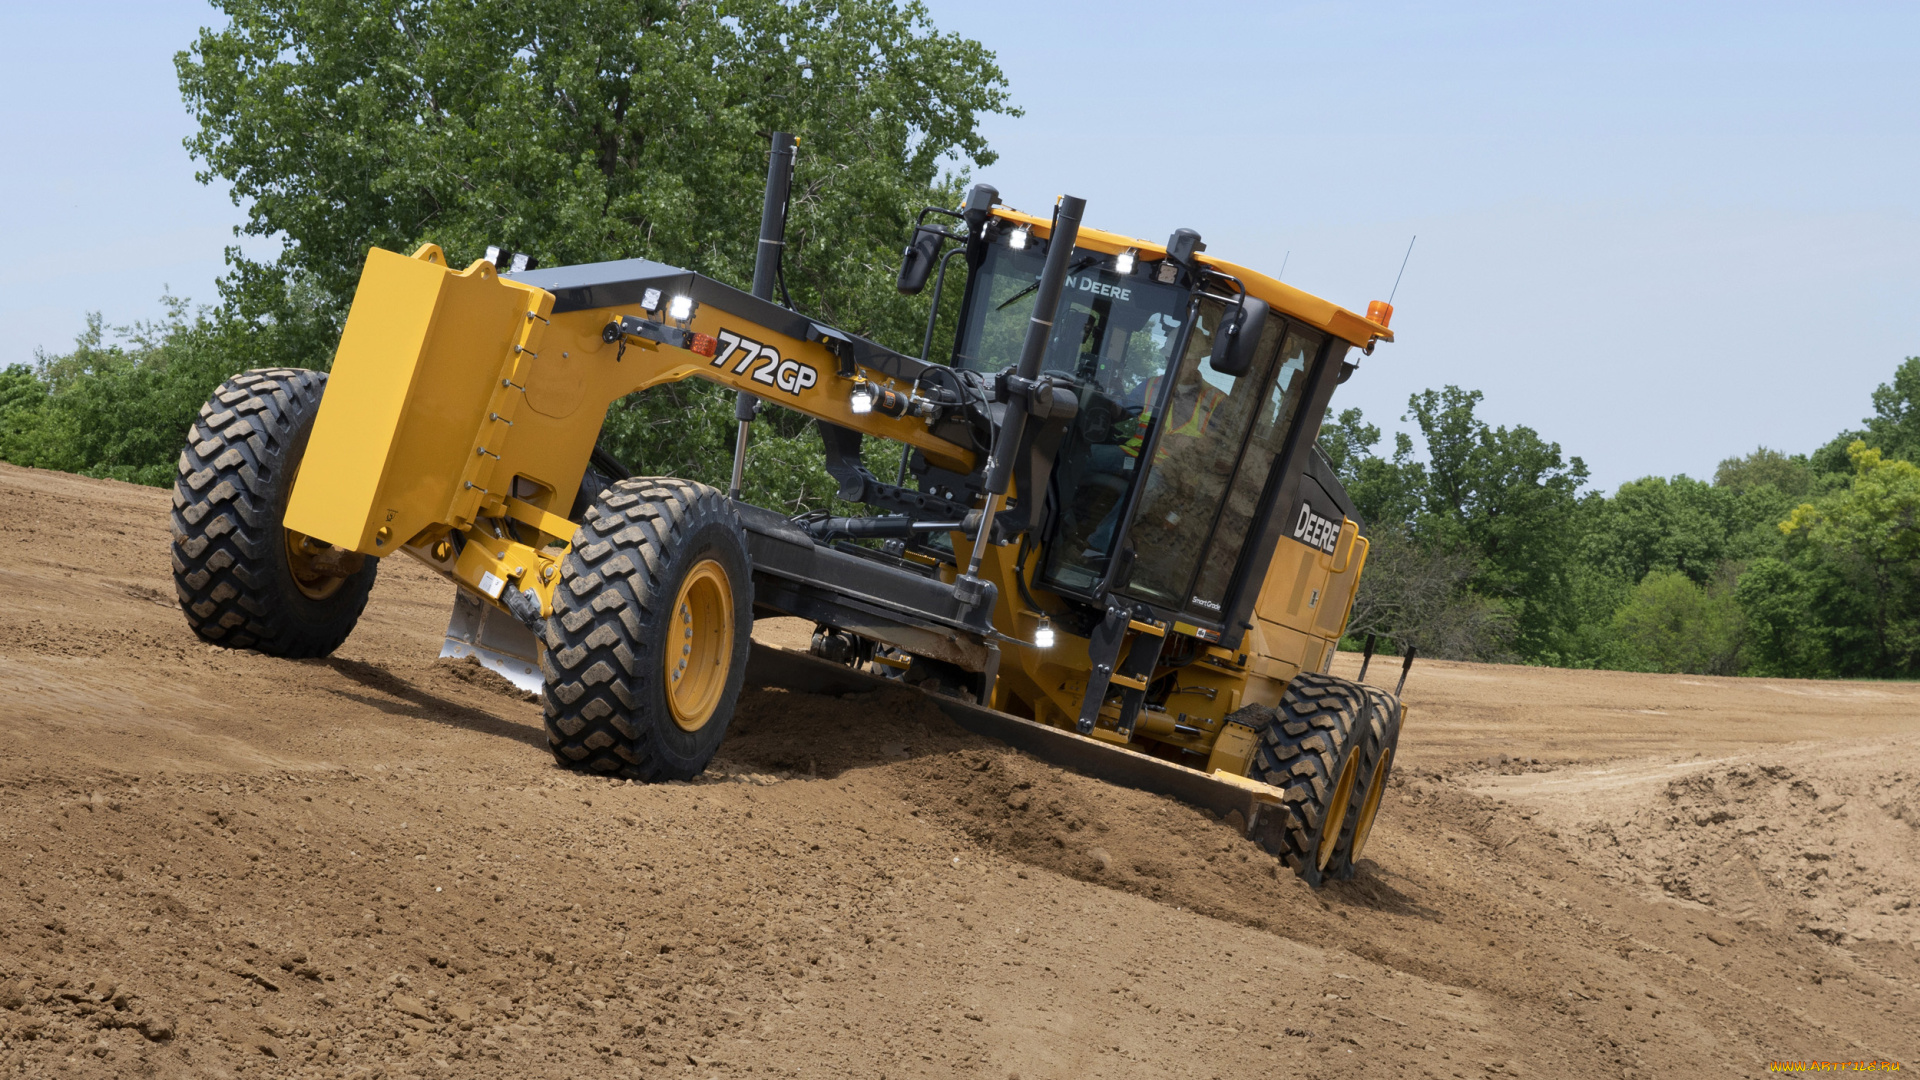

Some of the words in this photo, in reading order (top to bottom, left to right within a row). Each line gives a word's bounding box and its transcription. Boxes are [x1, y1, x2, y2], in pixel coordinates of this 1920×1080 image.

[1079, 276, 1131, 301] DEERE
[711, 329, 818, 395] 772GP
[1293, 502, 1340, 553] DEERE
